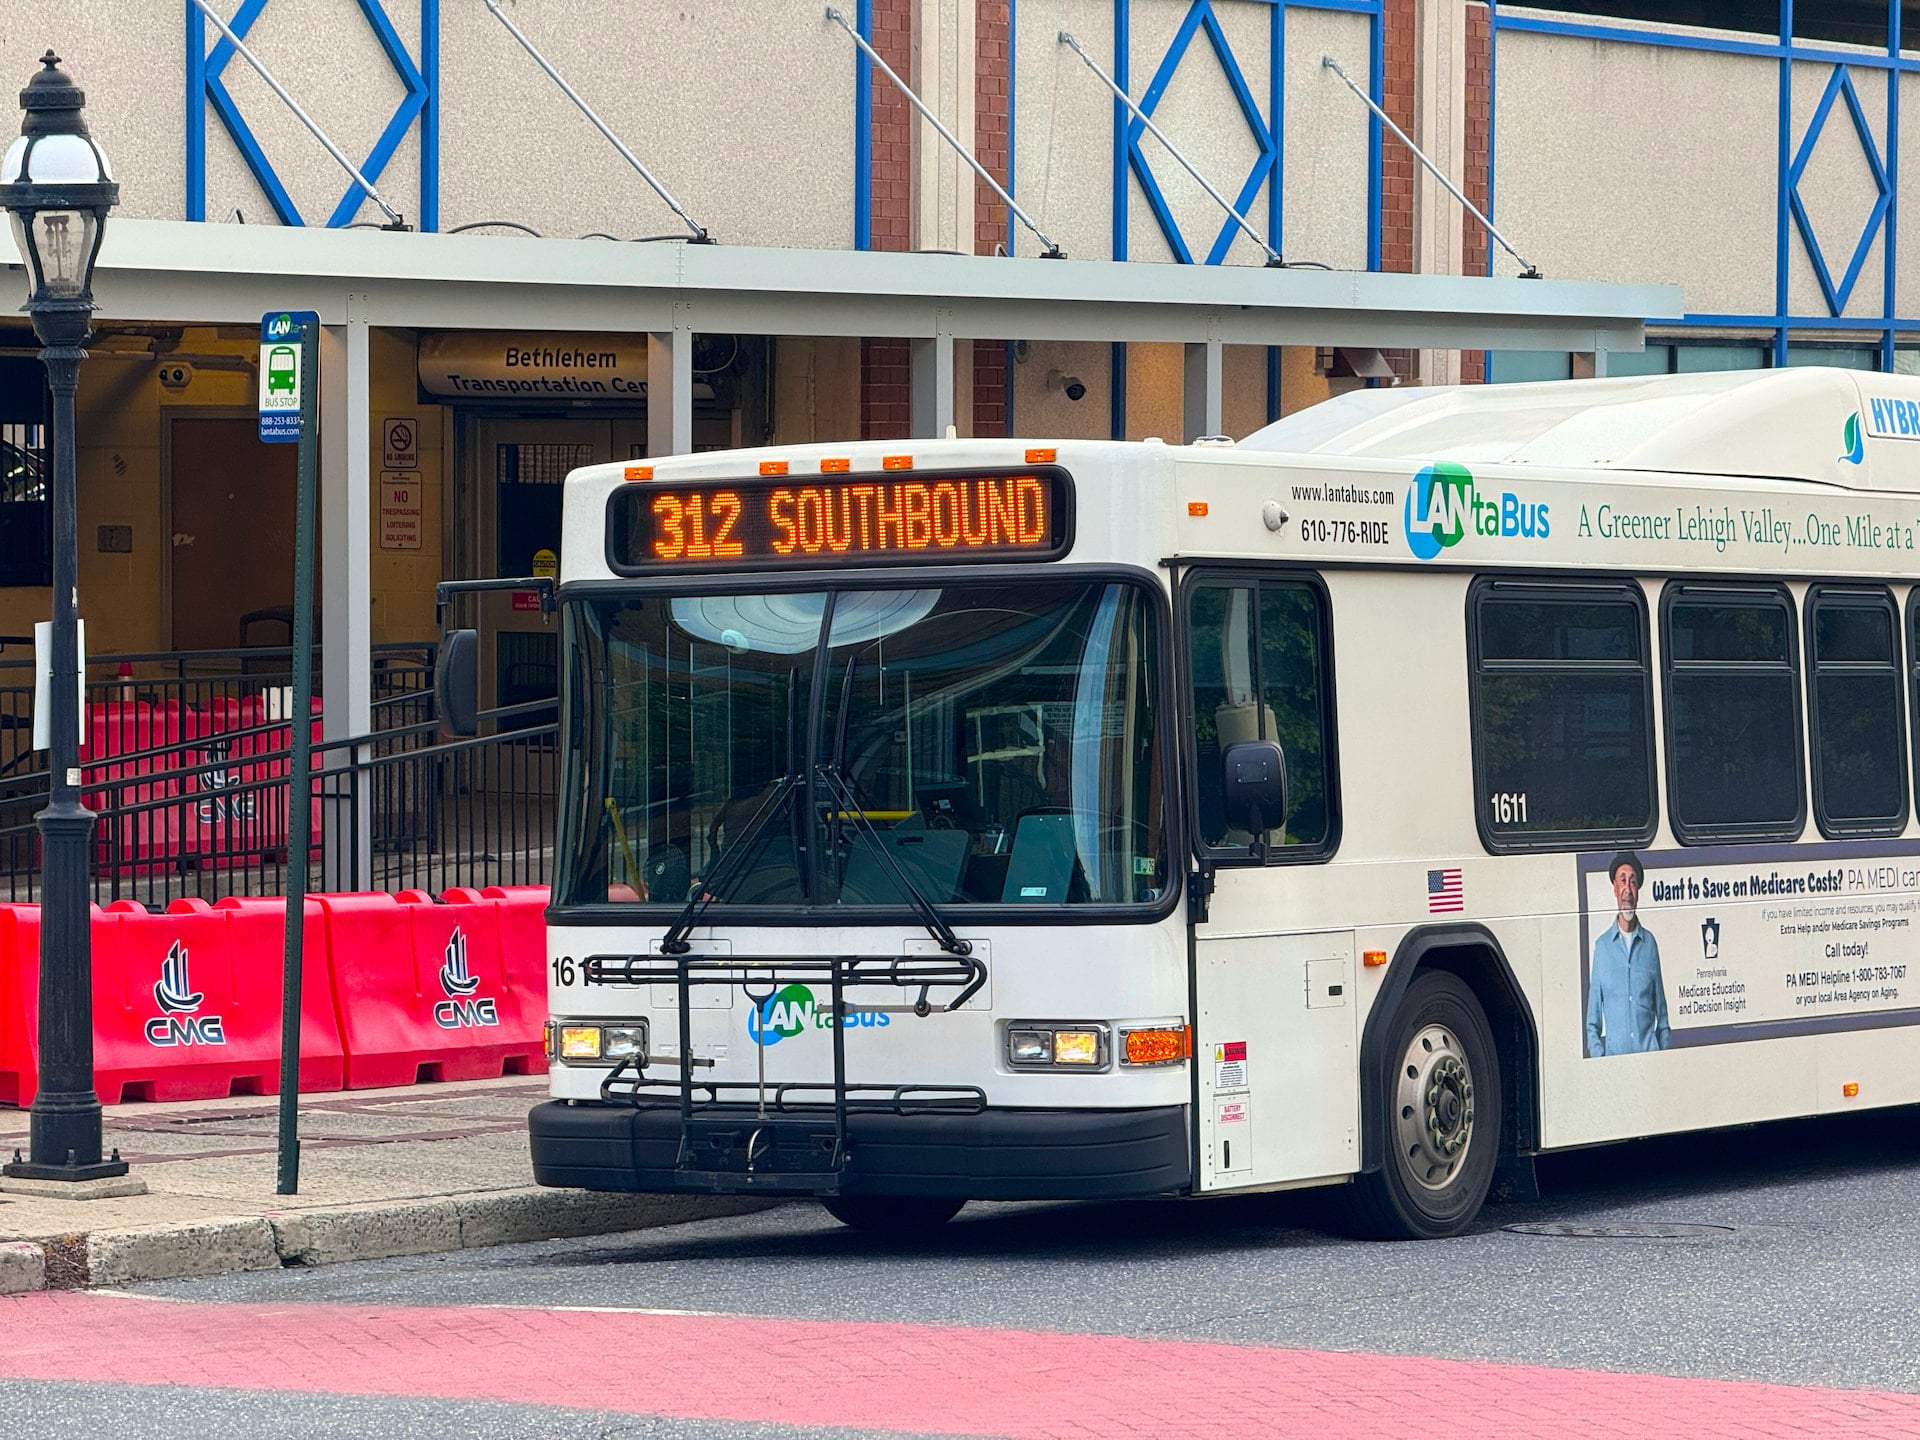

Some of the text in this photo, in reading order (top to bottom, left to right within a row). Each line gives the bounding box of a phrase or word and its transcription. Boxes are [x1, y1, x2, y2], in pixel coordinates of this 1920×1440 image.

[505, 347, 616, 368] Bethlehem
[449, 374, 605, 394] Transportation
[265, 397, 298, 407] BUS STOP
[1870, 397, 1920, 435] HYBR
[261, 427, 300, 436] lantabus.com
[394, 490, 409, 503] NO
[1292, 483, 1394, 505] www.lantabus.com
[382, 508, 419, 516] TRESPASSING
[653, 478, 1046, 558] 312 SOUTHBOUND
[1409, 481, 1550, 539] LANtaBus
[386, 520, 416, 529] LOITERING
[1301, 519, 1389, 545] 610-776-RIDE
[1577, 503, 1592, 538] A
[1598, 504, 1671, 540] Greener
[1677, 506, 1737, 552] Lehigh
[1845, 513, 1881, 548] Mile
[1887, 521, 1901, 549] at
[1905, 527, 1914, 550] a
[385, 534, 416, 542] SOLICITING
[1491, 792, 1527, 823] 1611
[1653, 877, 1685, 902] Want
[1687, 876, 1700, 899] to
[1702, 877, 1730, 898] Save
[1733, 880, 1747, 896] on
[1749, 871, 1805, 896] Medicare
[1808, 869, 1843, 893] Costs?
[1848, 868, 1865, 890] PA
[1868, 866, 1899, 889] MEDI
[1780, 918, 1910, 936] Extra Help and/or Medicare Savings Programs
[1825, 941, 1869, 959] Call today!
[1696, 967, 1727, 979] Pennsylvania
[1786, 965, 1907, 988] PA MEDI Helpline 1-800-783-7067
[1679, 981, 1746, 999] Medicare Education
[1796, 986, 1899, 1007] or your local Area Agency on Aging.
[434, 997, 500, 1029] CMG
[1679, 997, 1746, 1015] and Decision Insight
[145, 1016, 225, 1047] CMG
